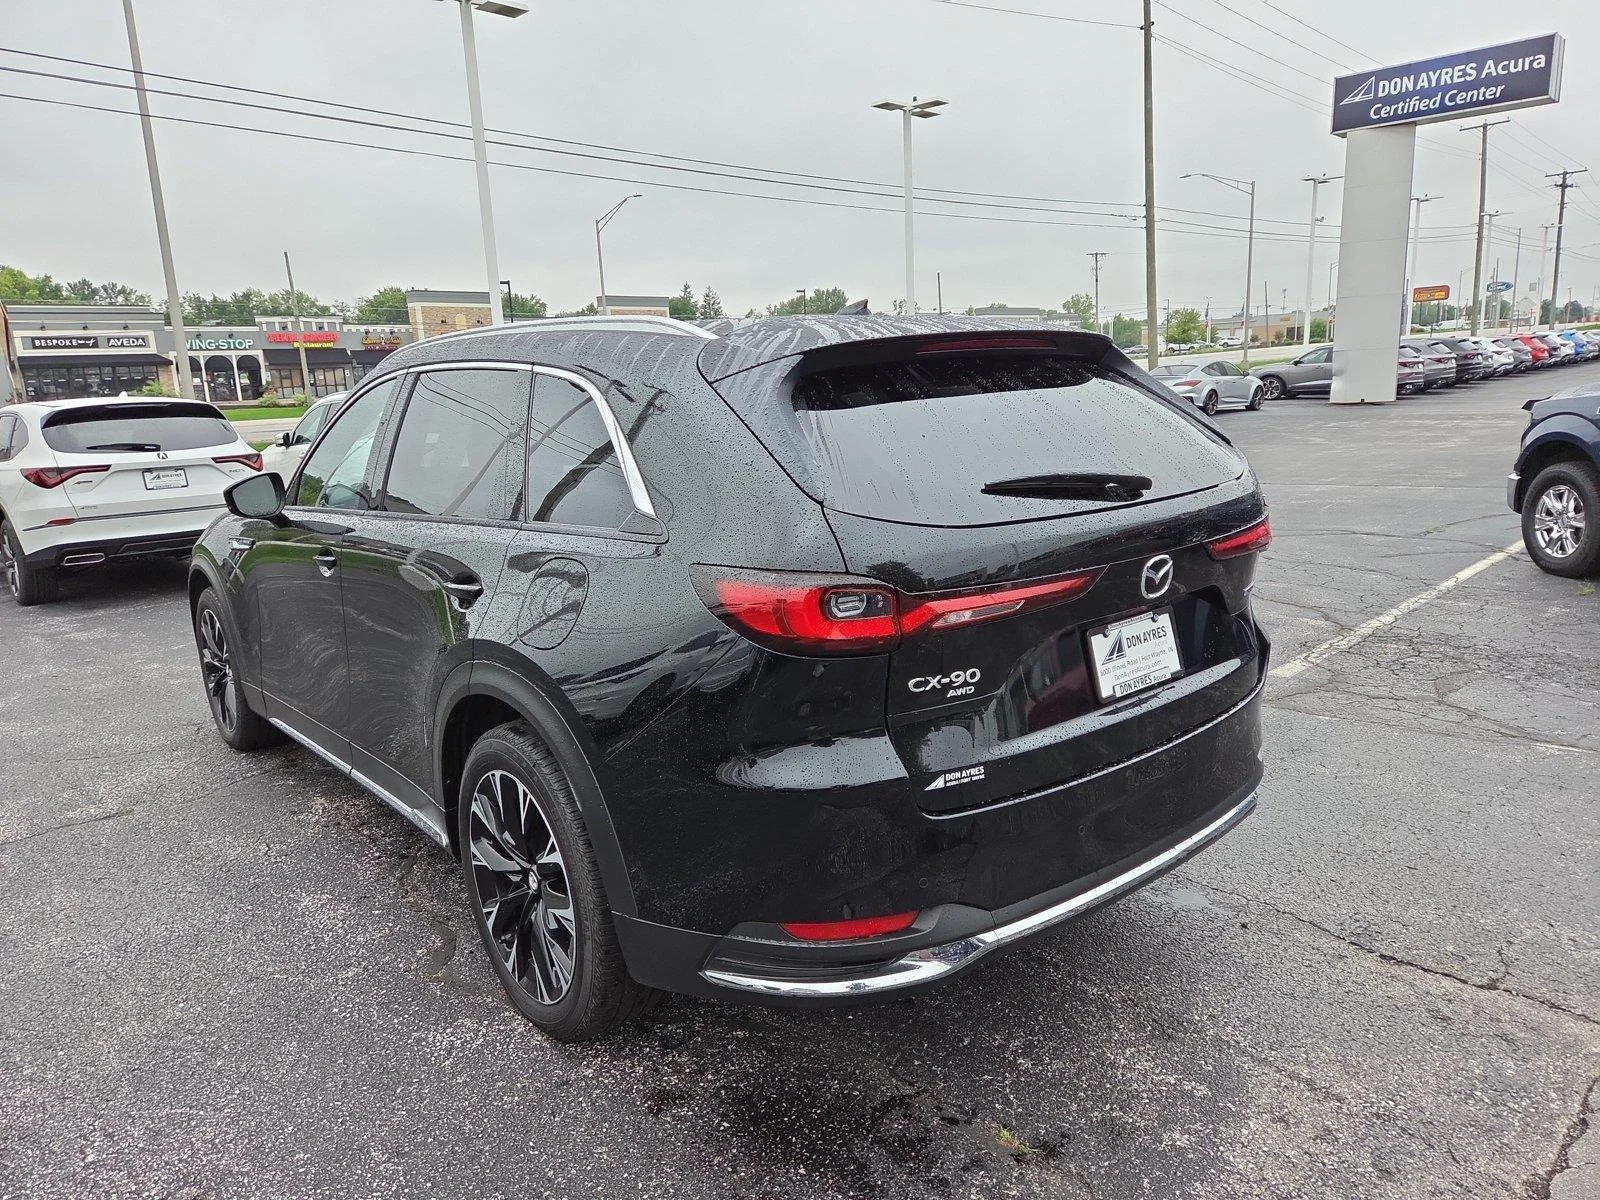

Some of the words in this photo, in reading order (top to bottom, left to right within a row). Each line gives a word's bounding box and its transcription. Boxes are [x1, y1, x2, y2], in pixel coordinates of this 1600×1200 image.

[1378, 74, 1415, 98] DON
[1416, 62, 1477, 90] AYRES
[1481, 53, 1546, 78] Acura
[1369, 92, 1440, 120] Certified
[1444, 83, 1505, 106] Center
[34, 338, 78, 347] BESPOKE
[108, 338, 146, 347] AVEDA
[1126, 633, 1142, 648] DON
[1142, 626, 1167, 643] AYRES
[908, 668, 981, 692] CX-90
[1120, 682, 1133, 694] DON
[1133, 675, 1152, 689] AYRES
[1153, 673, 1167, 682] Acura
[947, 686, 975, 698] AWD
[945, 771, 960, 781] DON
[961, 766, 985, 777] AYRES
